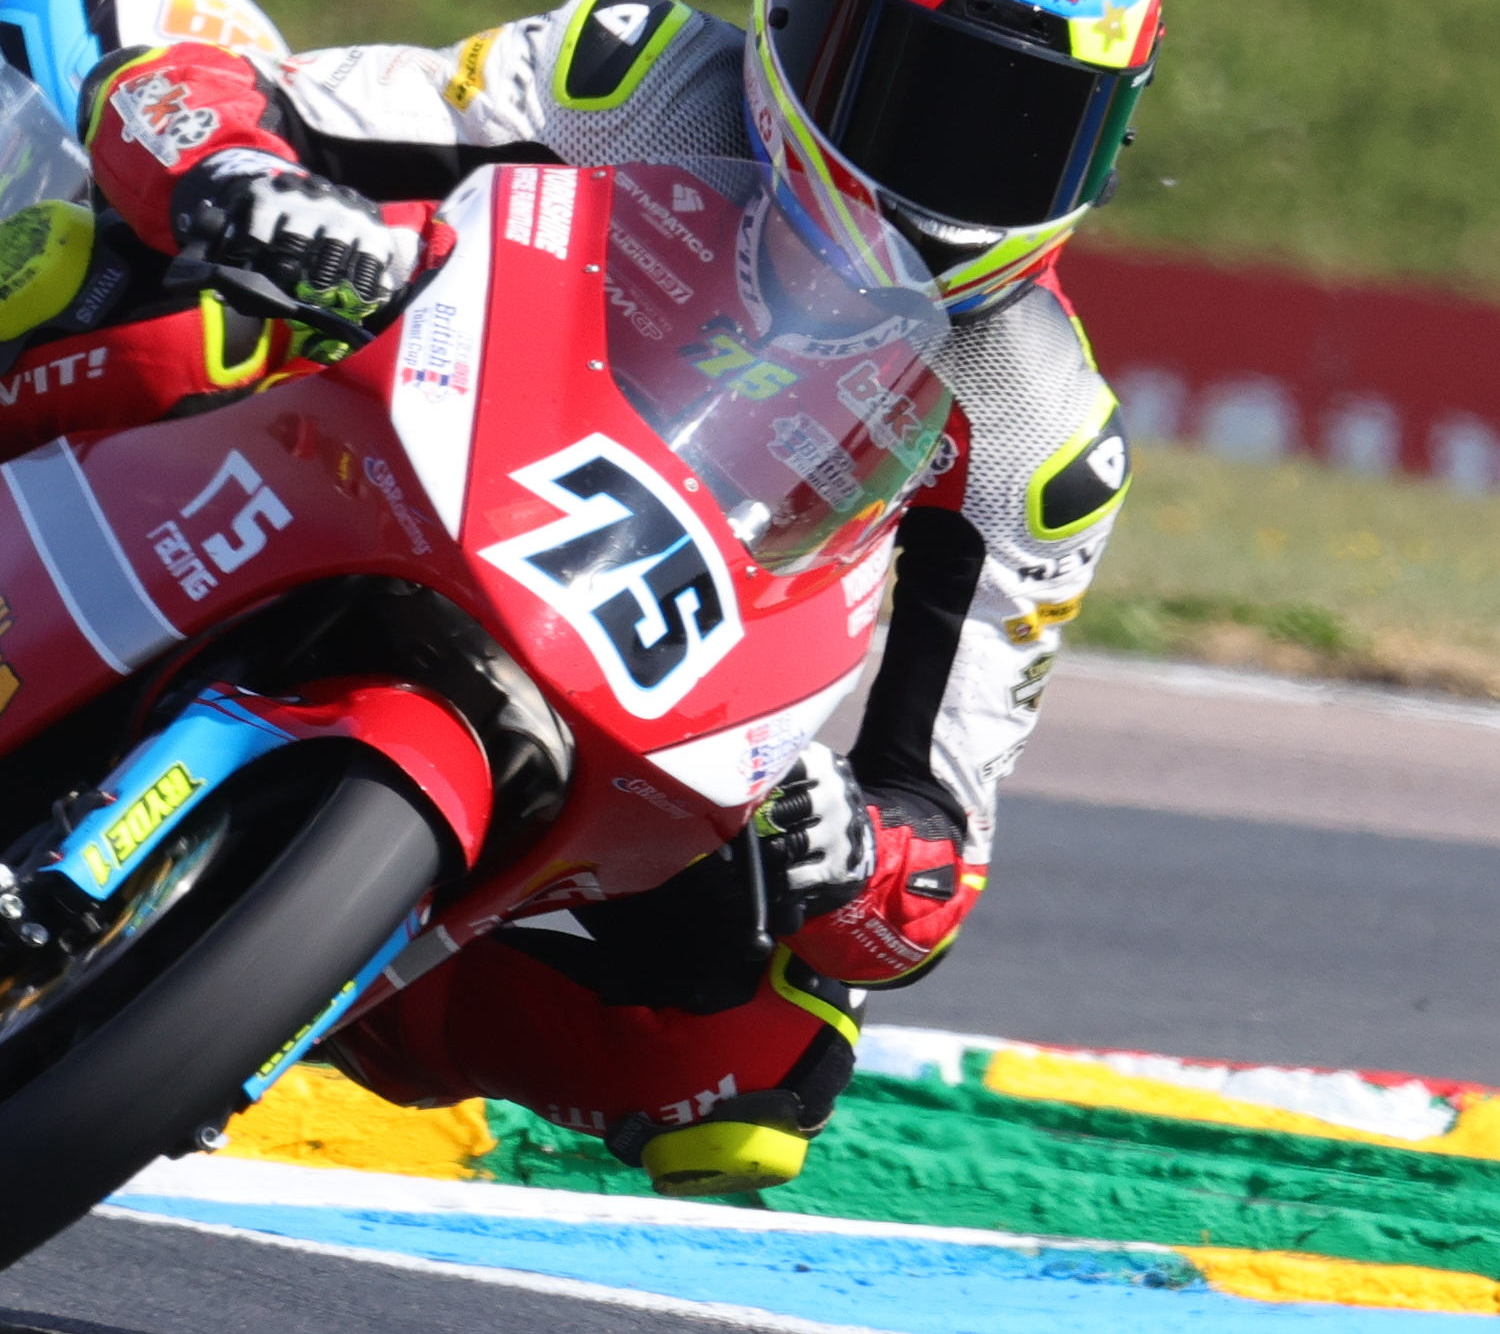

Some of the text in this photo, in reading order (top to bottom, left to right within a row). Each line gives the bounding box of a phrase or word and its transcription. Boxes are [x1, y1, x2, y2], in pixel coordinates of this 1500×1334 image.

[534, 167, 578, 261] YORKSHIRE
[428, 302, 457, 369] British
[147, 519, 219, 602] racing
[524, 452, 728, 692] 75
[82, 764, 198, 888] RYDE 1
